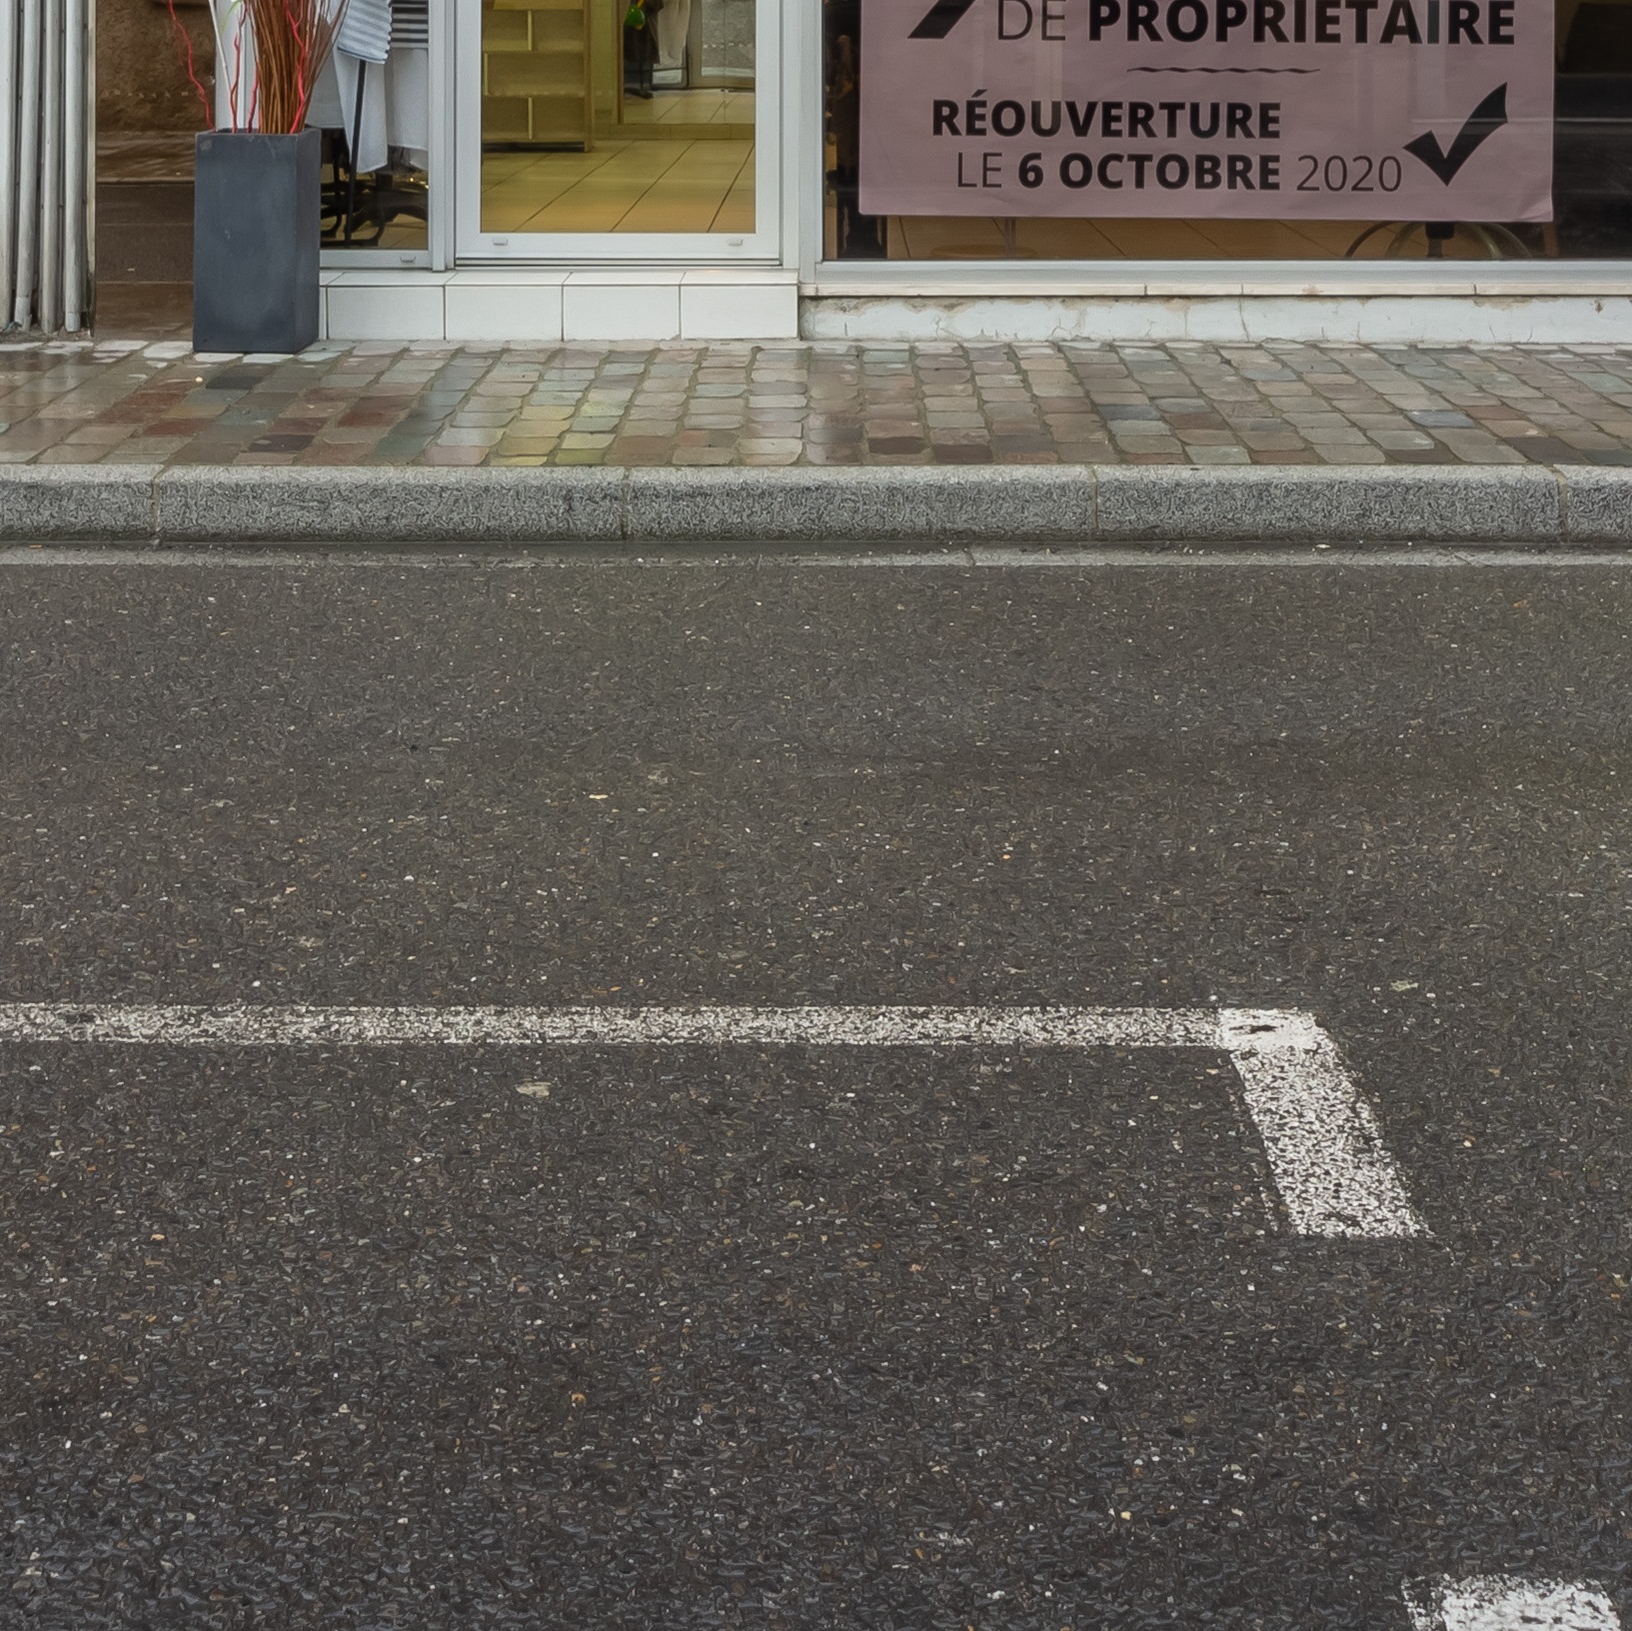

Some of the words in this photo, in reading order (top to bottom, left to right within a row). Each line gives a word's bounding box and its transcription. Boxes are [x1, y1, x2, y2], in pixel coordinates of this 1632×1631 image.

[932, 89, 1282, 140] RÉOUVERTURE
[956, 152, 1003, 189] LE
[1017, 152, 1045, 190] 6
[1058, 152, 1281, 191] OCTOBRE
[1296, 153, 1403, 193] 2020
